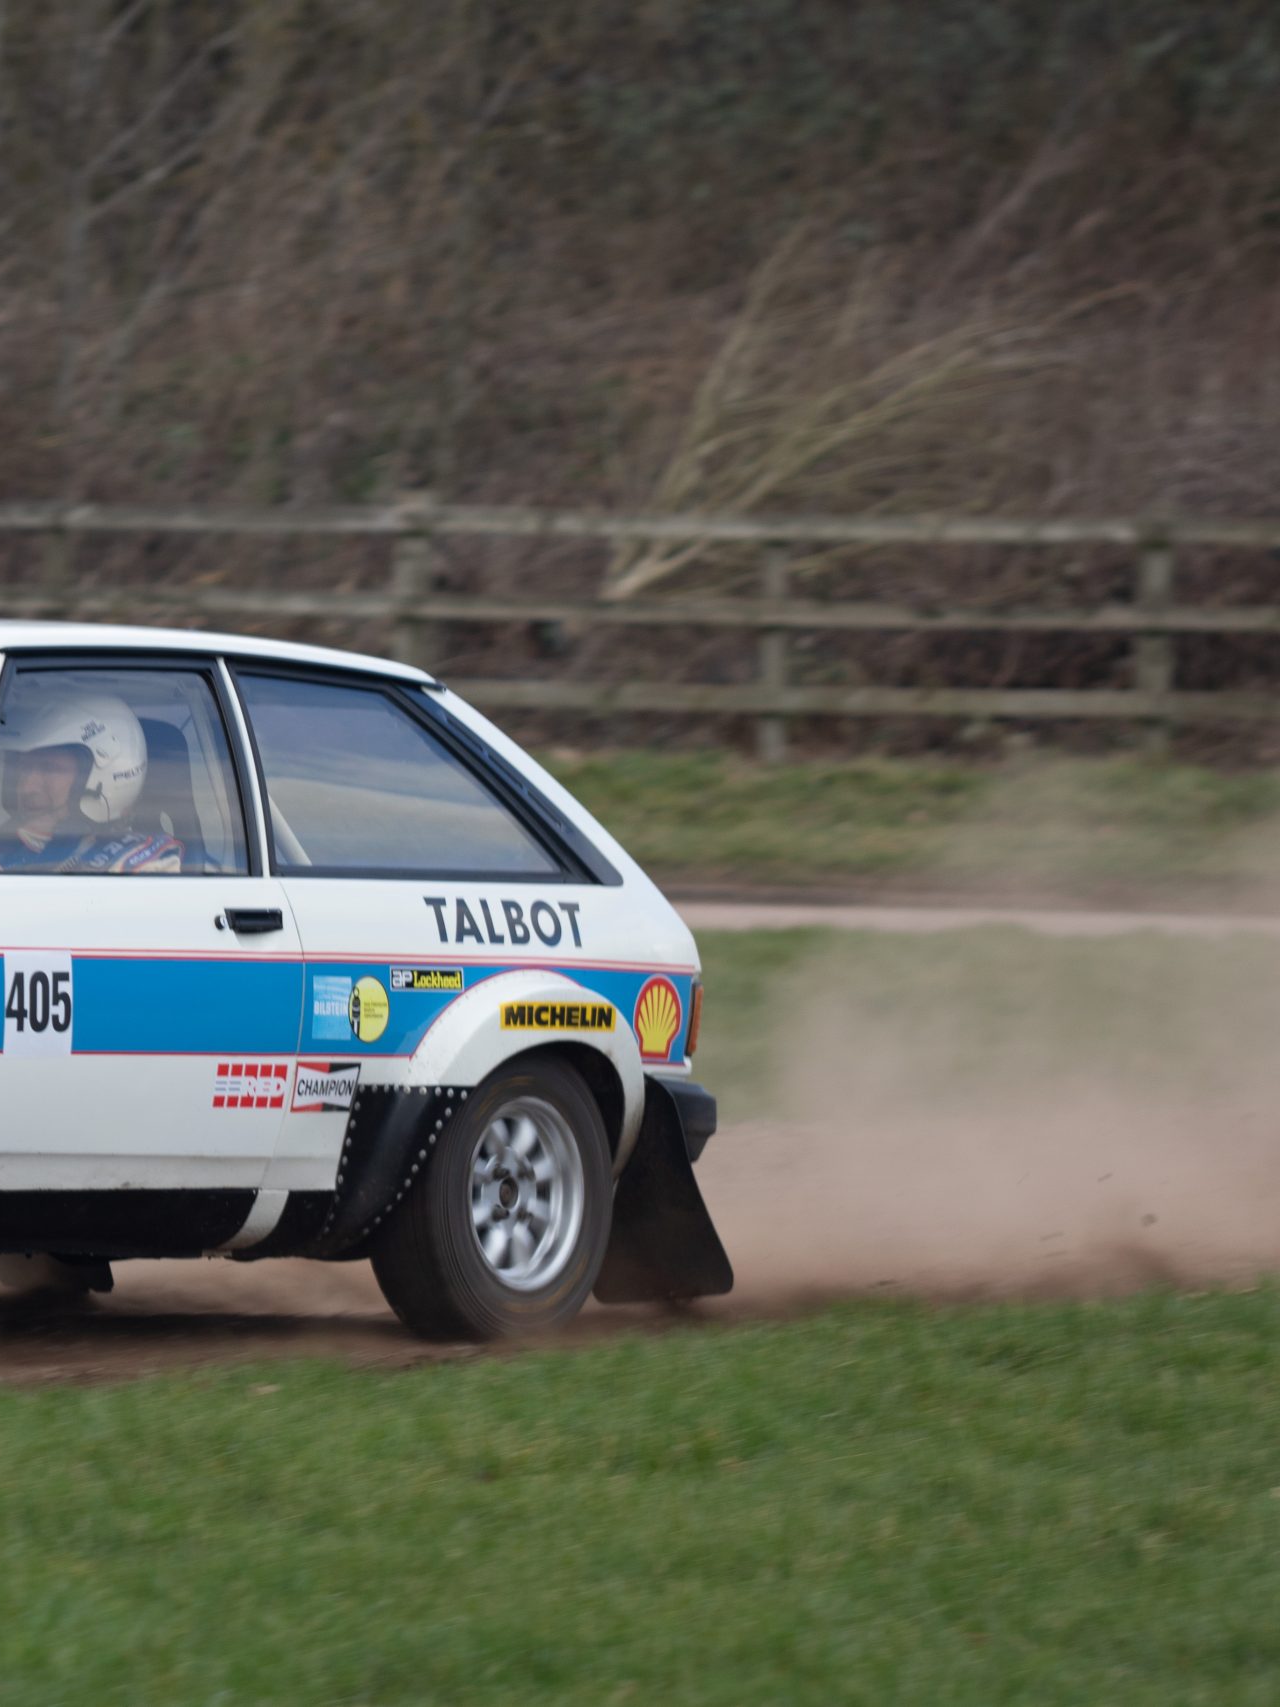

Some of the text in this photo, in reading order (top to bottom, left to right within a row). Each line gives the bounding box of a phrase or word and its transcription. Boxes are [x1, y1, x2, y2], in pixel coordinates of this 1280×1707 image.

[423, 896, 582, 948] TALBOT
[5, 970, 71, 1033] 405
[504, 1005, 613, 1028] MICHELIN
[297, 1078, 354, 1097] CHAMPION
